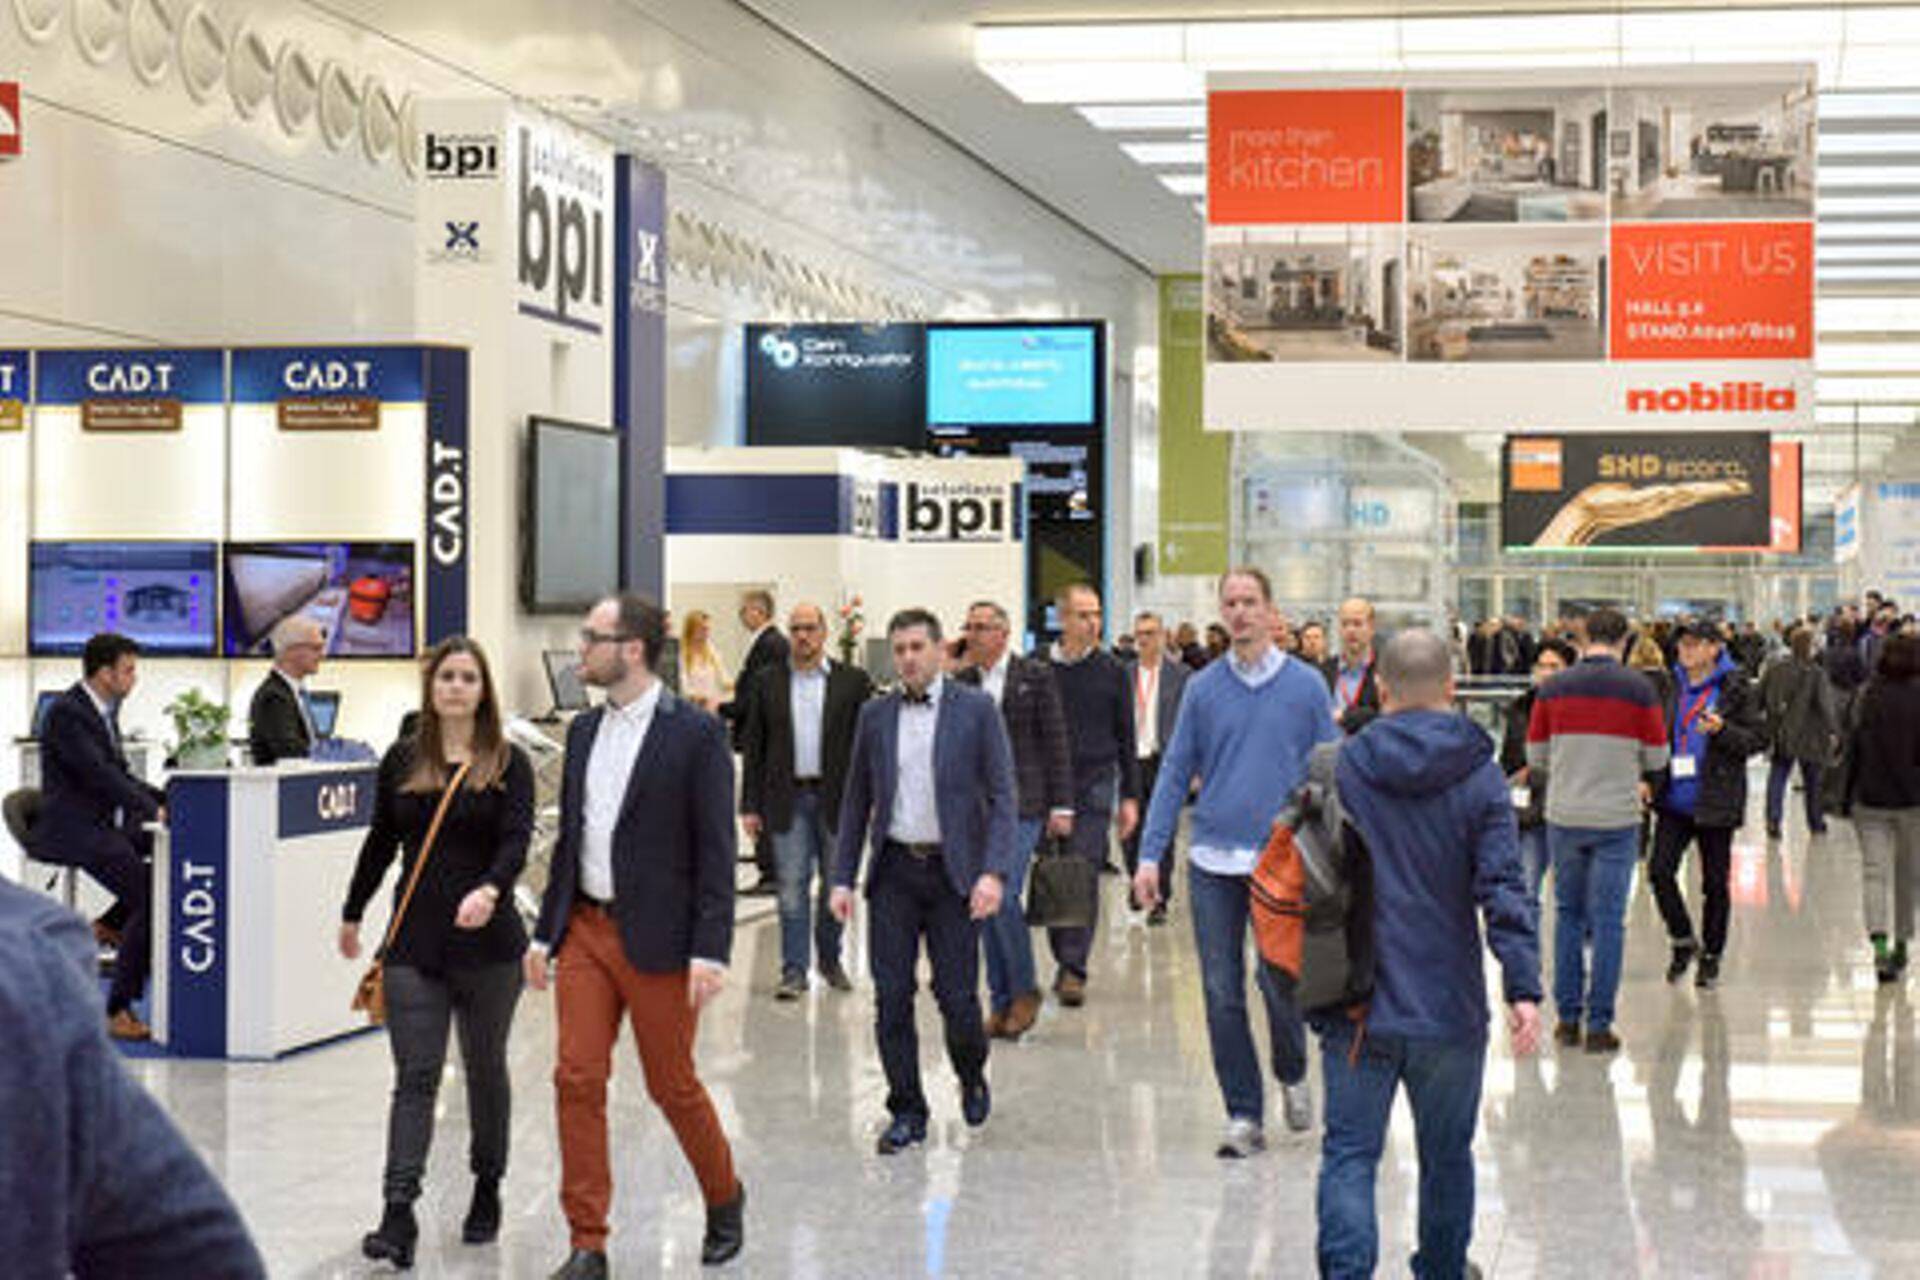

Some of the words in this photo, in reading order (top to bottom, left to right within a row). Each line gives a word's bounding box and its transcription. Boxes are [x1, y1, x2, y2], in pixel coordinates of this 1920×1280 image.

[426, 133, 496, 178] bpi
[1229, 148, 1384, 190] kitchen
[518, 126, 603, 320] bpi
[1625, 240, 1727, 276] VISIT
[1740, 239, 1797, 276] US
[1626, 300, 1671, 316] HALL
[1627, 324, 1688, 342] STAND
[88, 364, 173, 392] CAD.T
[284, 362, 371, 390] CAD.T
[1627, 381, 1797, 412] nobilia
[1597, 453, 1663, 479] SHD
[433, 442, 463, 564] CAD.T
[906, 482, 1004, 540] bpi
[182, 860, 216, 973] CAD.T
